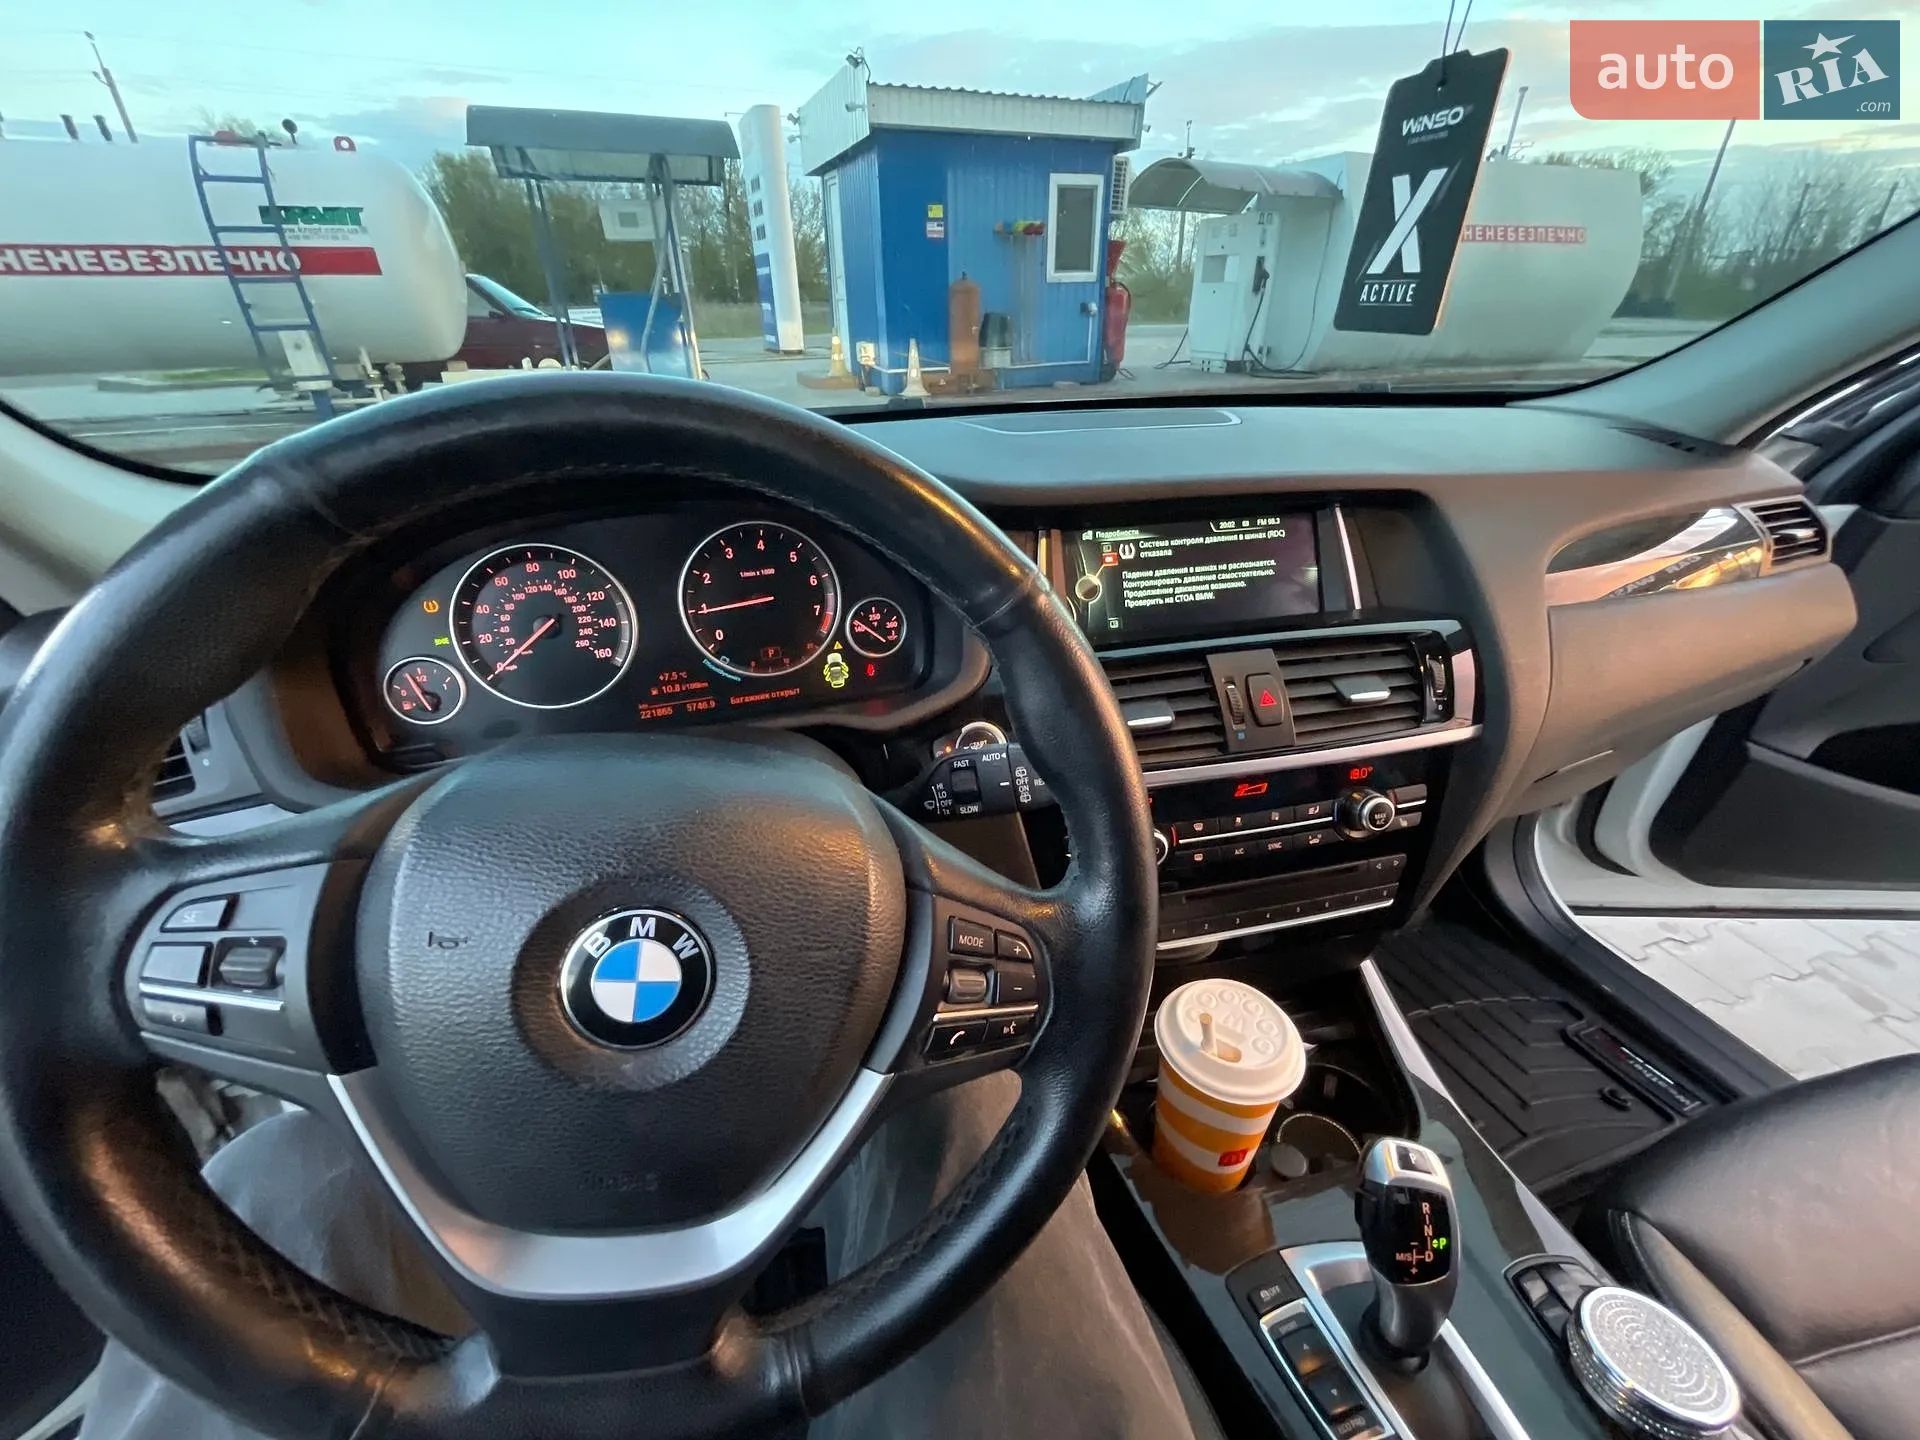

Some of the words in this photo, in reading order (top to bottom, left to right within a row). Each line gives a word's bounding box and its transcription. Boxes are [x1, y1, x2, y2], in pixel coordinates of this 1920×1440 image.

[1366, 168, 1448, 274] X
[1360, 283, 1416, 303] ACTIVE
[1257, 518, 1267, 526] FM
[1095, 529, 1140, 540] Подробности
[757, 540, 765, 551] 4
[1139, 539, 1169, 549] Система
[1170, 537, 1204, 546] контроля
[1205, 534, 1238, 544] давления
[1244, 532, 1267, 540] шинах
[725, 548, 733, 559] 3
[789, 551, 798, 563] 5
[1140, 549, 1173, 558] отказала
[525, 562, 540, 573] 80
[1122, 570, 1154, 580] Падение
[1154, 567, 1189, 577] давления
[1195, 564, 1217, 573] шинах
[1218, 563, 1227, 571] не
[1228, 559, 1277, 571] распознается.
[557, 569, 576, 580] 100
[702, 573, 712, 584] 2
[809, 574, 818, 586] 6
[1123, 578, 1182, 589] Контролировать
[1183, 574, 1217, 584] давление
[1217, 569, 1276, 580] самостоятельно.
[494, 576, 509, 587] 60
[524, 585, 538, 594] 120
[1124, 588, 1173, 599] Продолжение
[1174, 584, 1210, 594] движения
[1210, 581, 1247, 590] возможно.
[511, 593, 526, 601] 100
[586, 590, 605, 602] 120
[1124, 598, 1164, 608] Проверить
[1164, 596, 1174, 604] на
[475, 604, 490, 614] 40
[572, 605, 587, 613] 200
[813, 605, 821, 616] 7
[577, 616, 592, 624] 220
[598, 617, 617, 629] 140
[578, 628, 593, 636] 240
[715, 629, 724, 641] 0
[478, 634, 493, 645] 20
[505, 638, 516, 646] 20
[575, 640, 590, 648] 260
[593, 648, 612, 659] 160
[415, 674, 428, 682] 1/2
[401, 689, 407, 697] 0
[730, 692, 770, 705] Багажник
[770, 687, 801, 699] открыт
[982, 753, 1001, 762] AUTO
[954, 760, 969, 769] FAST
[1016, 777, 1029, 786] OFF
[1019, 785, 1030, 793] ON
[938, 791, 947, 799] LO
[940, 800, 953, 808] OFF
[960, 806, 979, 815] SLOW
[1234, 847, 1244, 856] A/C
[1267, 841, 1283, 851] SYNC
[583, 916, 699, 960] BMW
[958, 934, 984, 948] MODE
[1409, 1152, 1416, 1165] P
[1422, 1202, 1430, 1214] R
[1424, 1224, 1433, 1236] N
[1439, 1237, 1447, 1249] P
[1395, 1252, 1412, 1261] M/S
[1425, 1251, 1433, 1262] D
